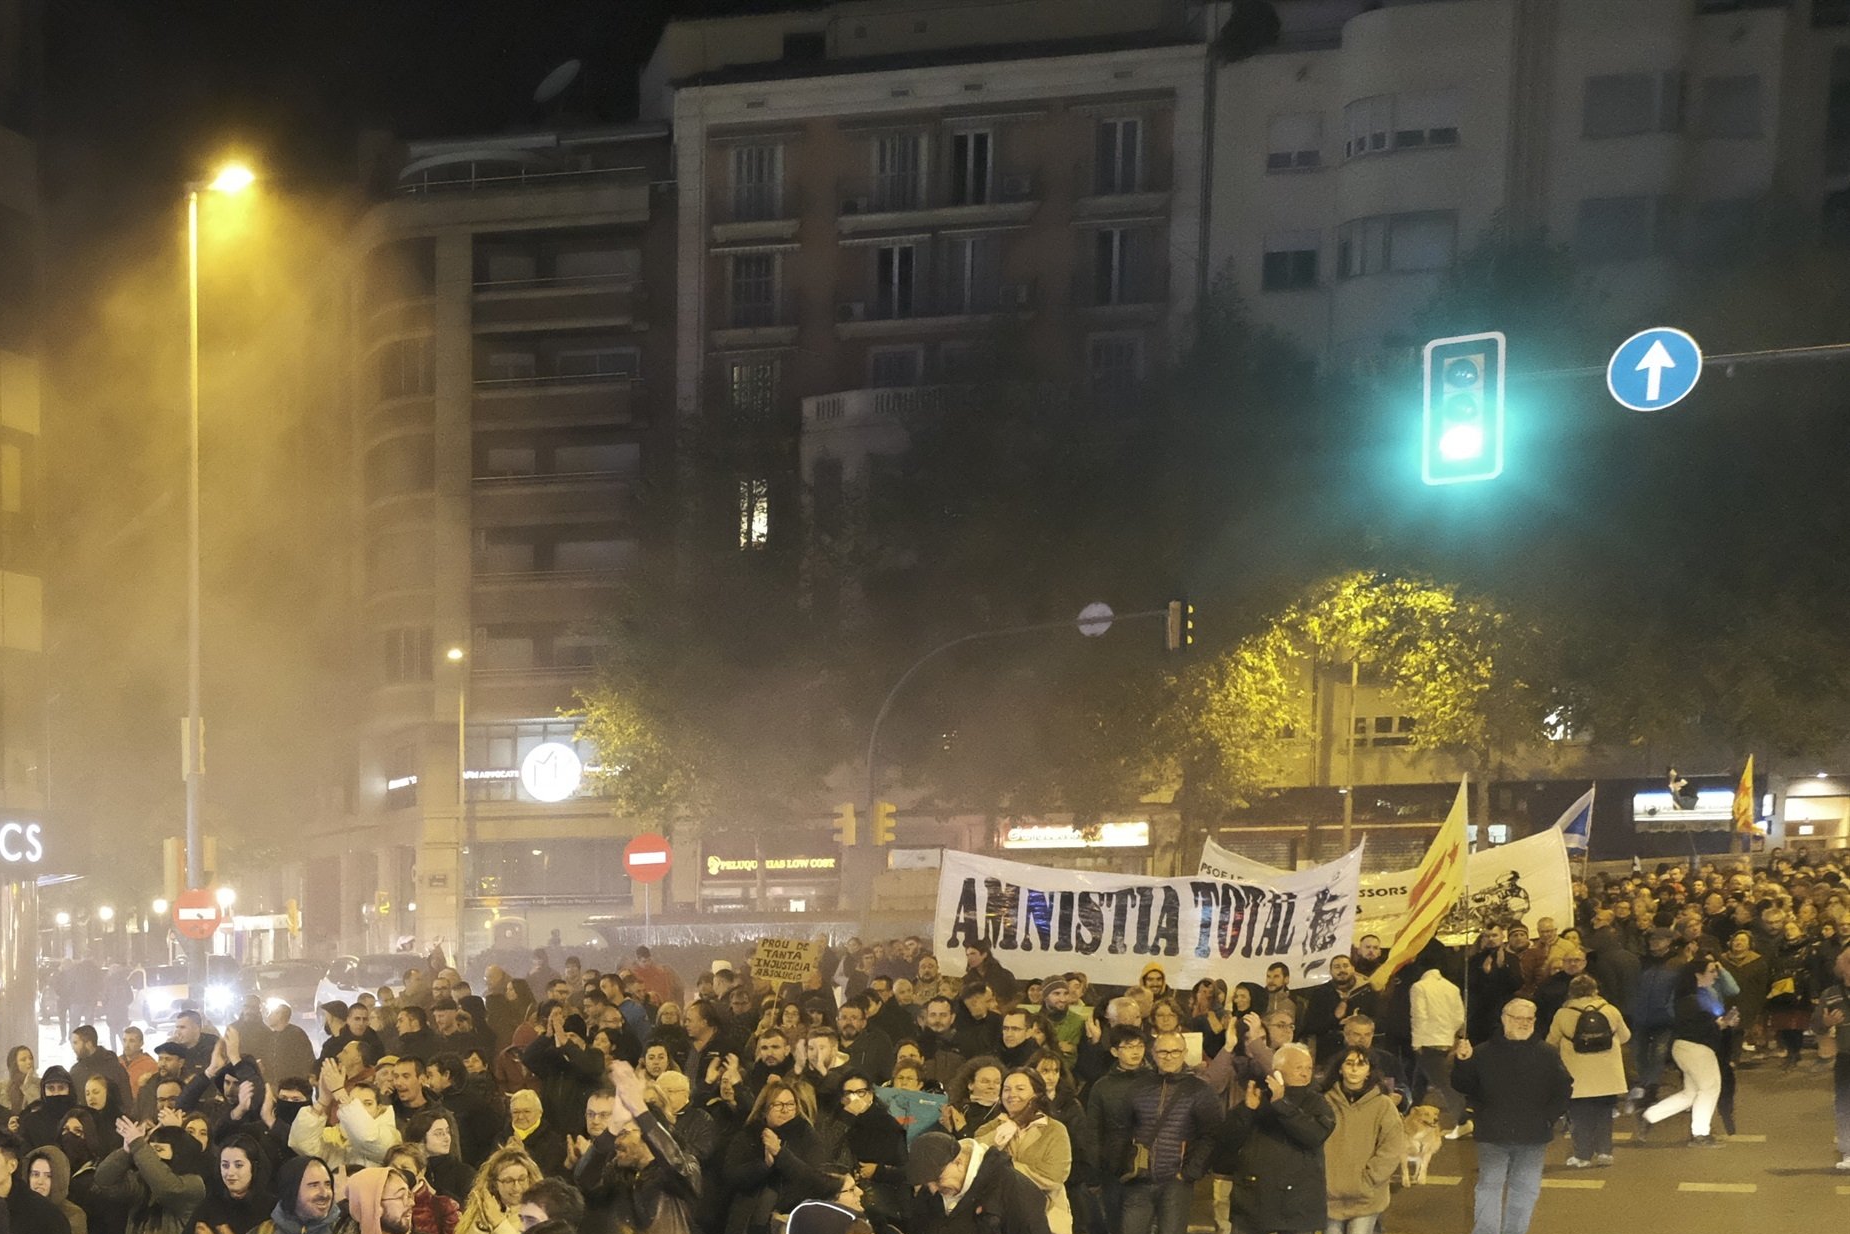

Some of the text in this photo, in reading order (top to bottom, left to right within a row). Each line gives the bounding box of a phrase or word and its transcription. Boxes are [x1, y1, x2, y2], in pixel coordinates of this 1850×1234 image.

[946, 876, 1297, 960] AMNISTIA TOTAL
[761, 938, 810, 951] PROU DE
[763, 949, 802, 960] TANTA
[754, 957, 810, 972] INJUSTICIA
